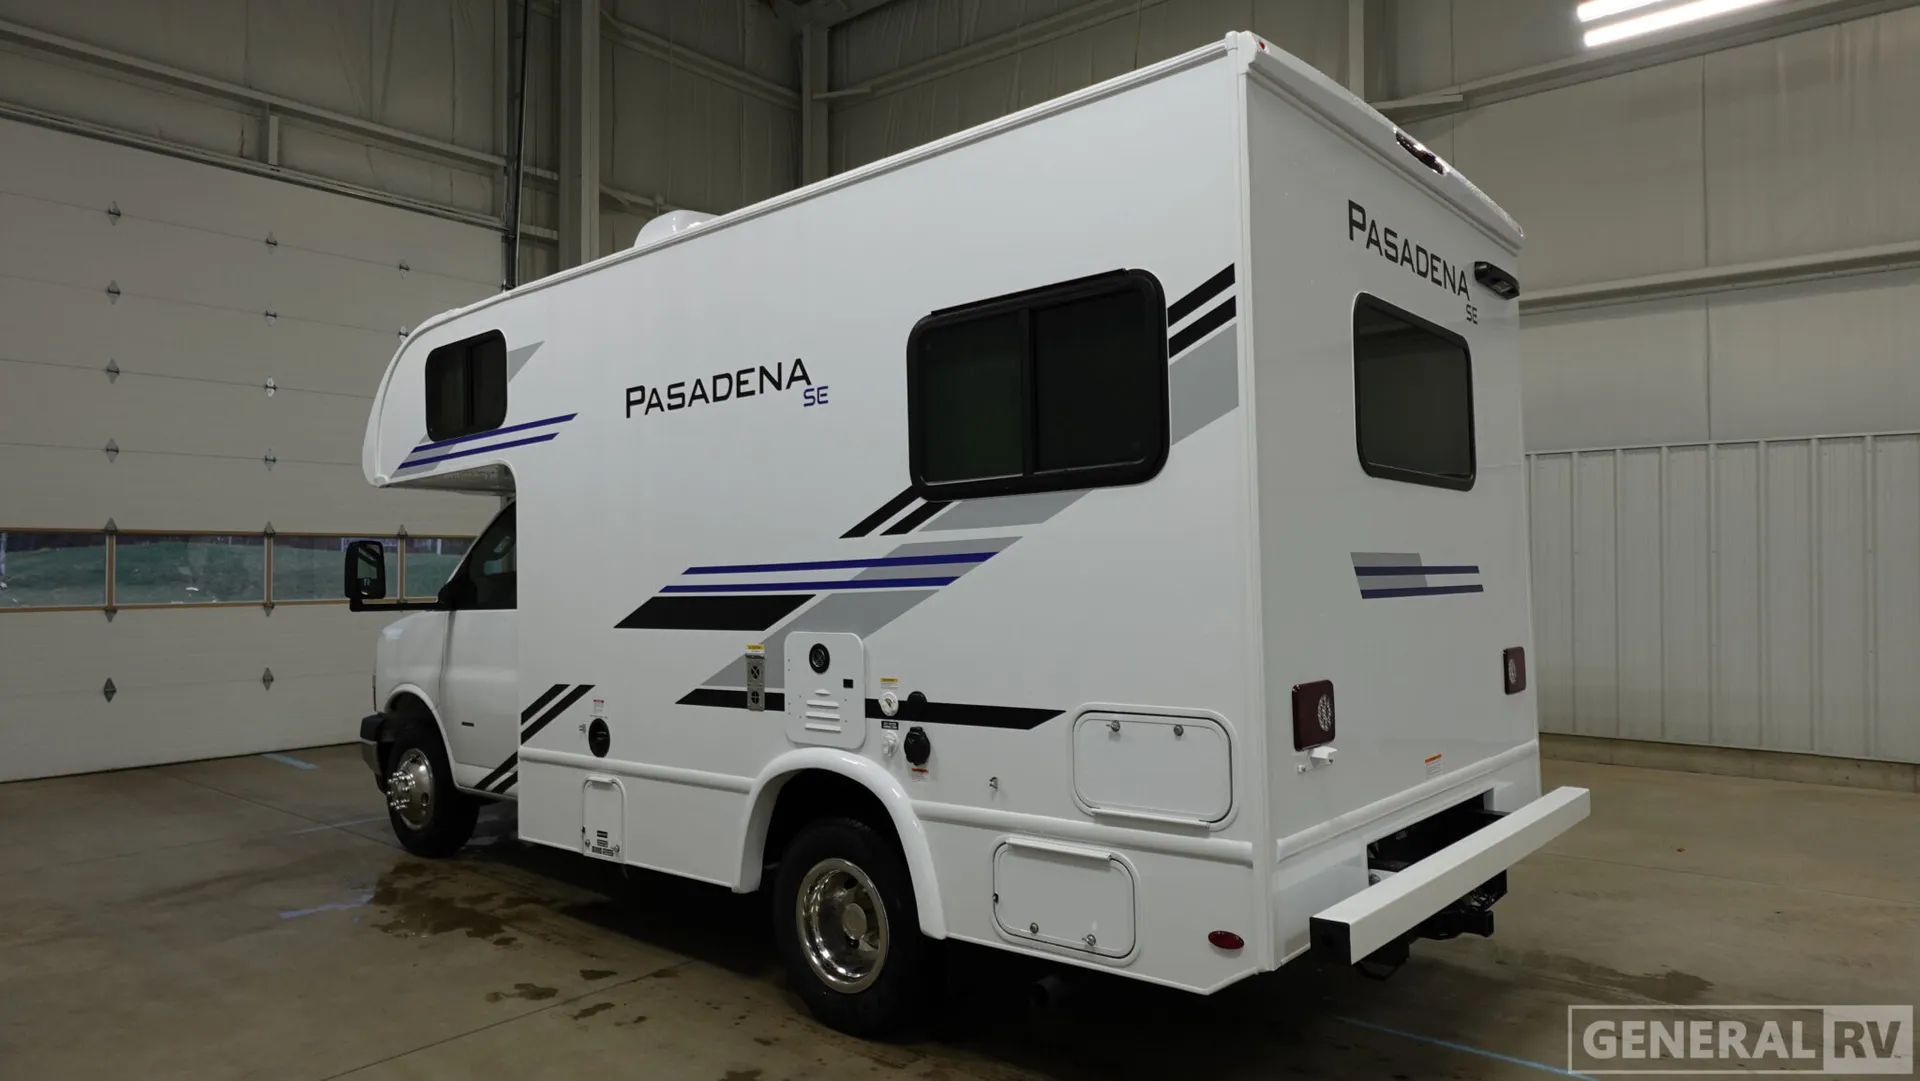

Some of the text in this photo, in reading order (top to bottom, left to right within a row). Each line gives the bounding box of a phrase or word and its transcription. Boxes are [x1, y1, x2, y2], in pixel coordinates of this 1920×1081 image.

[1348, 199, 1471, 301] PASADENA
[1465, 304, 1478, 325] SE
[626, 358, 812, 418] PASADENA
[803, 385, 829, 407] SE
